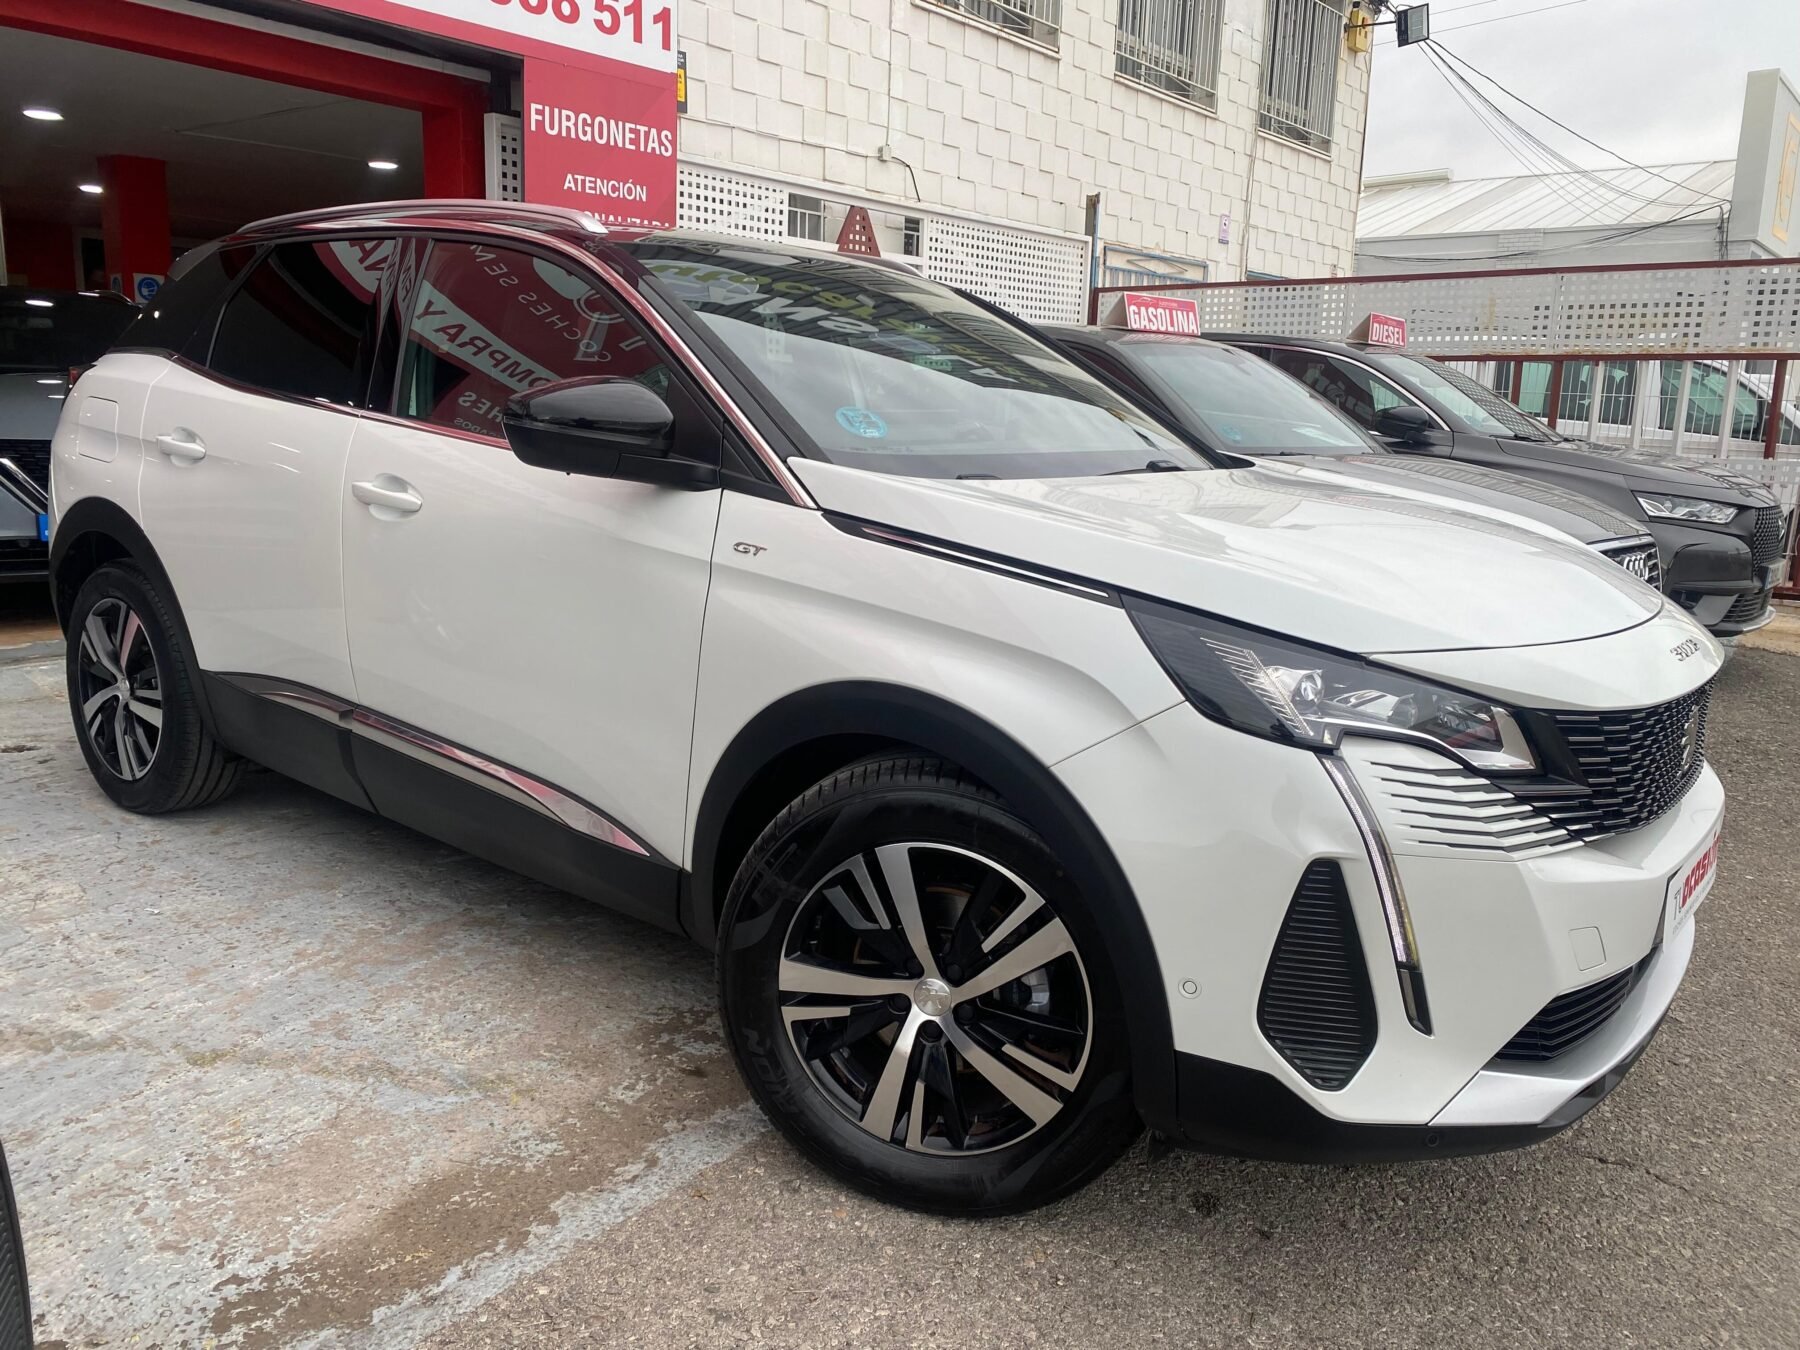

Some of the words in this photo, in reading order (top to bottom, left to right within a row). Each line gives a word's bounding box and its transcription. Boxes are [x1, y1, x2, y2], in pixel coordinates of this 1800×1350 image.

[594, 0, 671, 51] 511
[530, 102, 673, 157] FURGONETAS
[563, 173, 647, 202] ATENCIÓN
[1129, 304, 1198, 334] GASOLINA
[1371, 322, 1405, 346] DIESEL
[733, 541, 768, 556] GT
